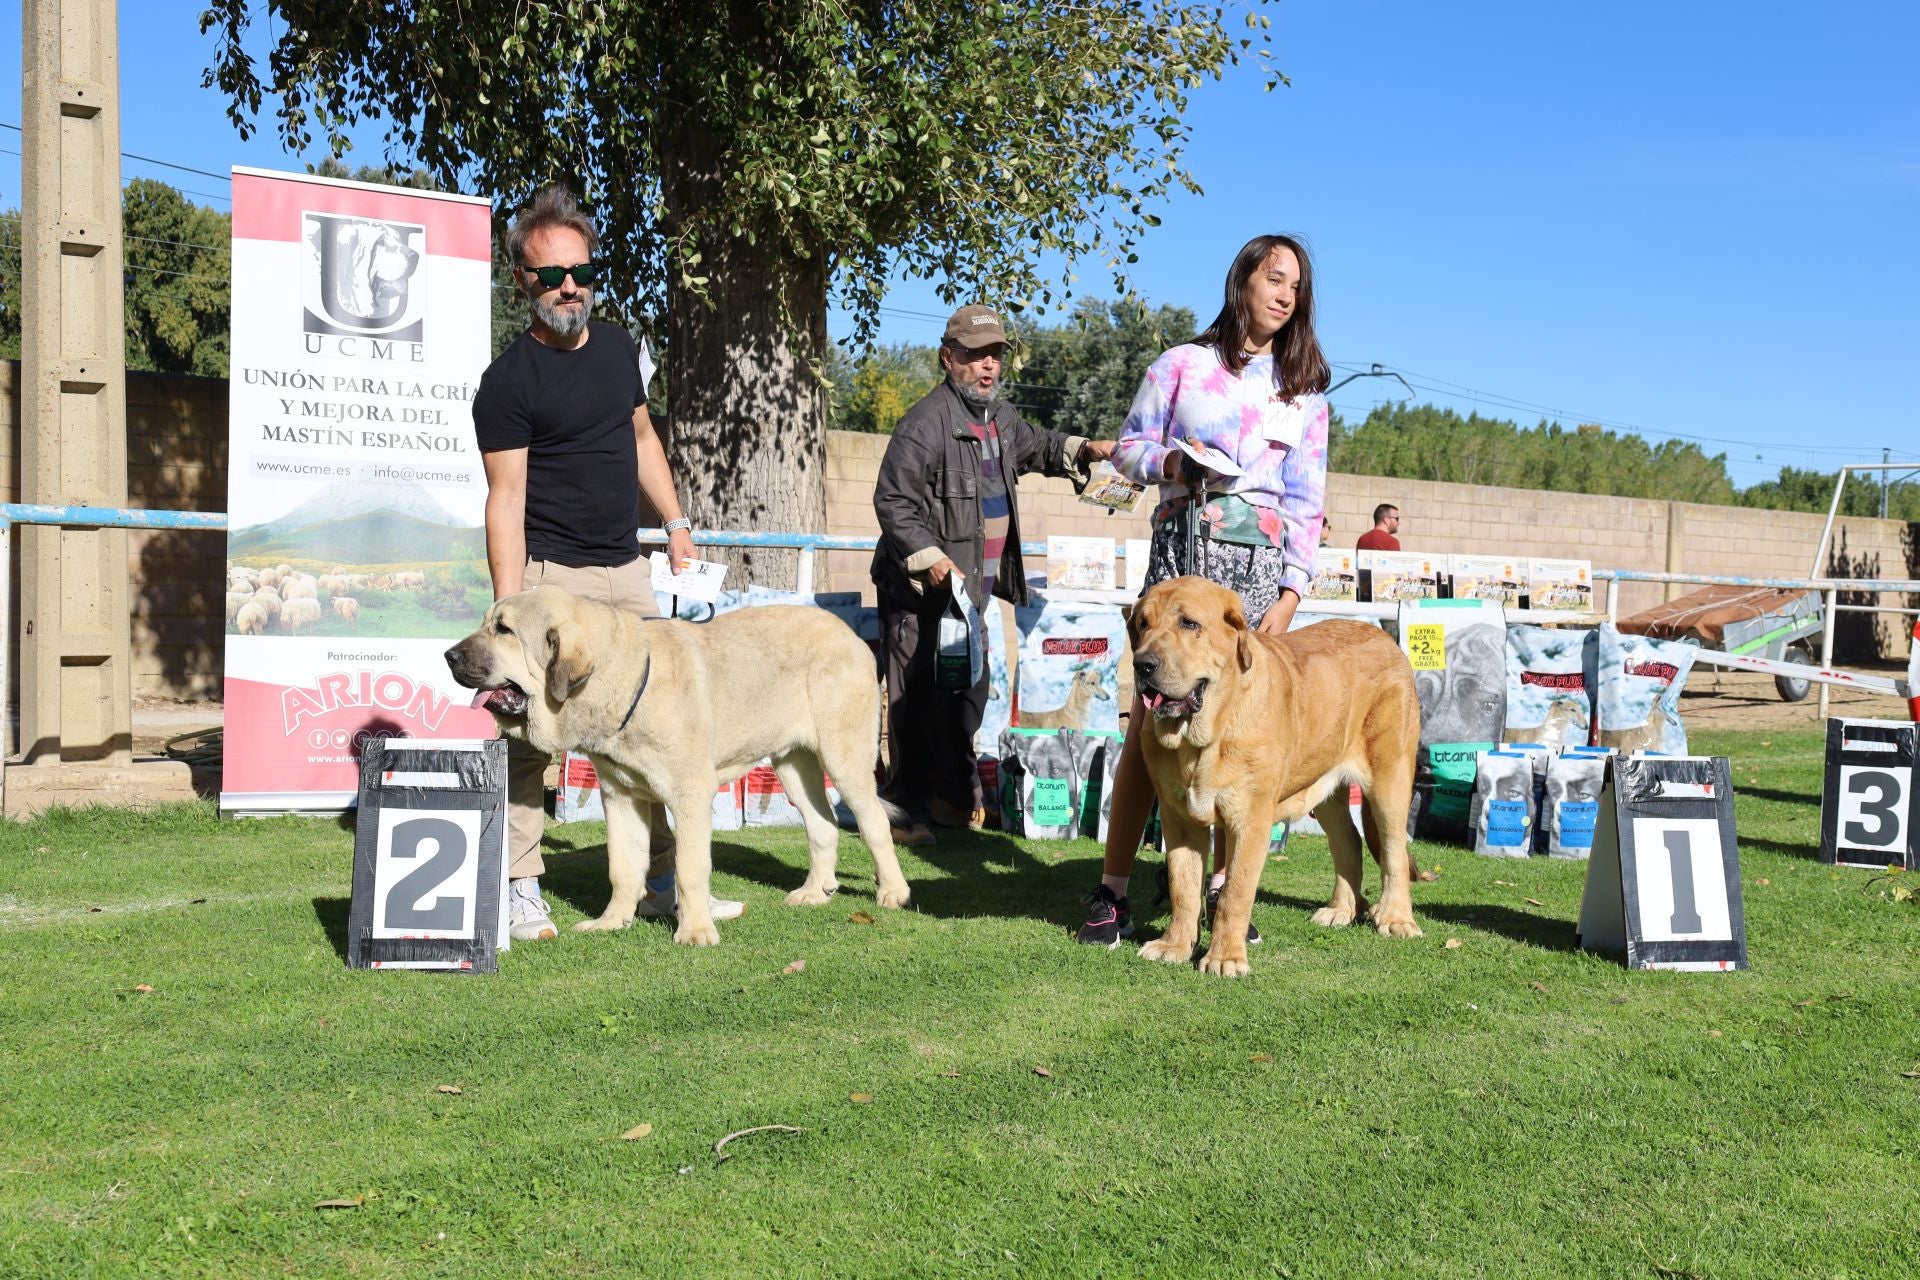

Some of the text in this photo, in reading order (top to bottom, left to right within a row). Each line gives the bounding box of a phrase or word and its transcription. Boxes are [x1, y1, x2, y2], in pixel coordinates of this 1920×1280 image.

[243, 368, 325, 391] UNIÓN
[333, 376, 389, 395] PARA
[396, 381, 424, 398] LA
[279, 398, 448, 426] Y MEJORA DEL
[262, 425, 465, 453] MASTÍN ESPAÑOL
[256, 461, 470, 483] www.ucme.es info@ucme.es
[327, 651, 398, 662] Patrocinador:
[282, 669, 453, 737] ARION
[307, 754, 362, 763] www.arion
[1844, 770, 1902, 847] 3
[384, 817, 468, 931] 2
[1662, 829, 1703, 934] 1
